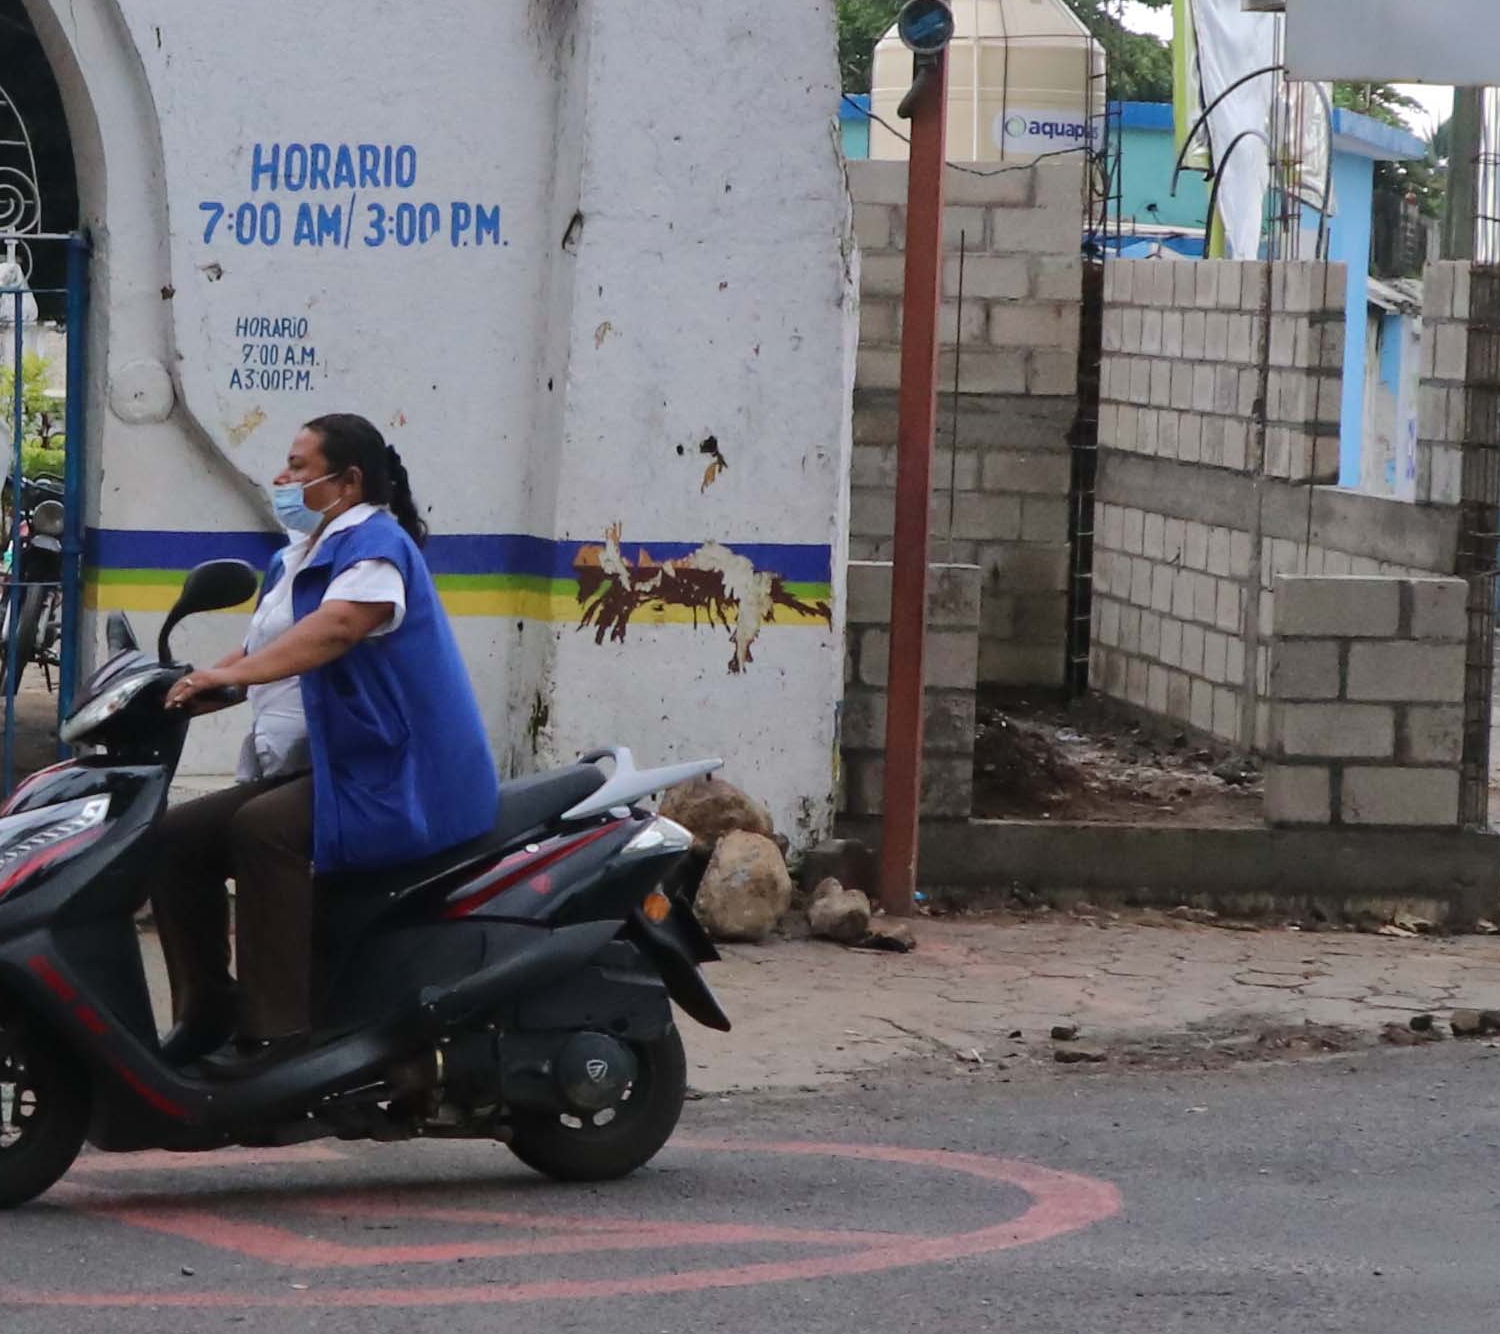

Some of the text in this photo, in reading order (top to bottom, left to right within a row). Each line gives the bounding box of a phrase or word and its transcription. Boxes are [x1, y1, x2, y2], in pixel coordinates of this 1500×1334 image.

[251, 143, 416, 191] HORARIO
[199, 202, 281, 245] 7:00
[236, 316, 308, 339] HORARIO
